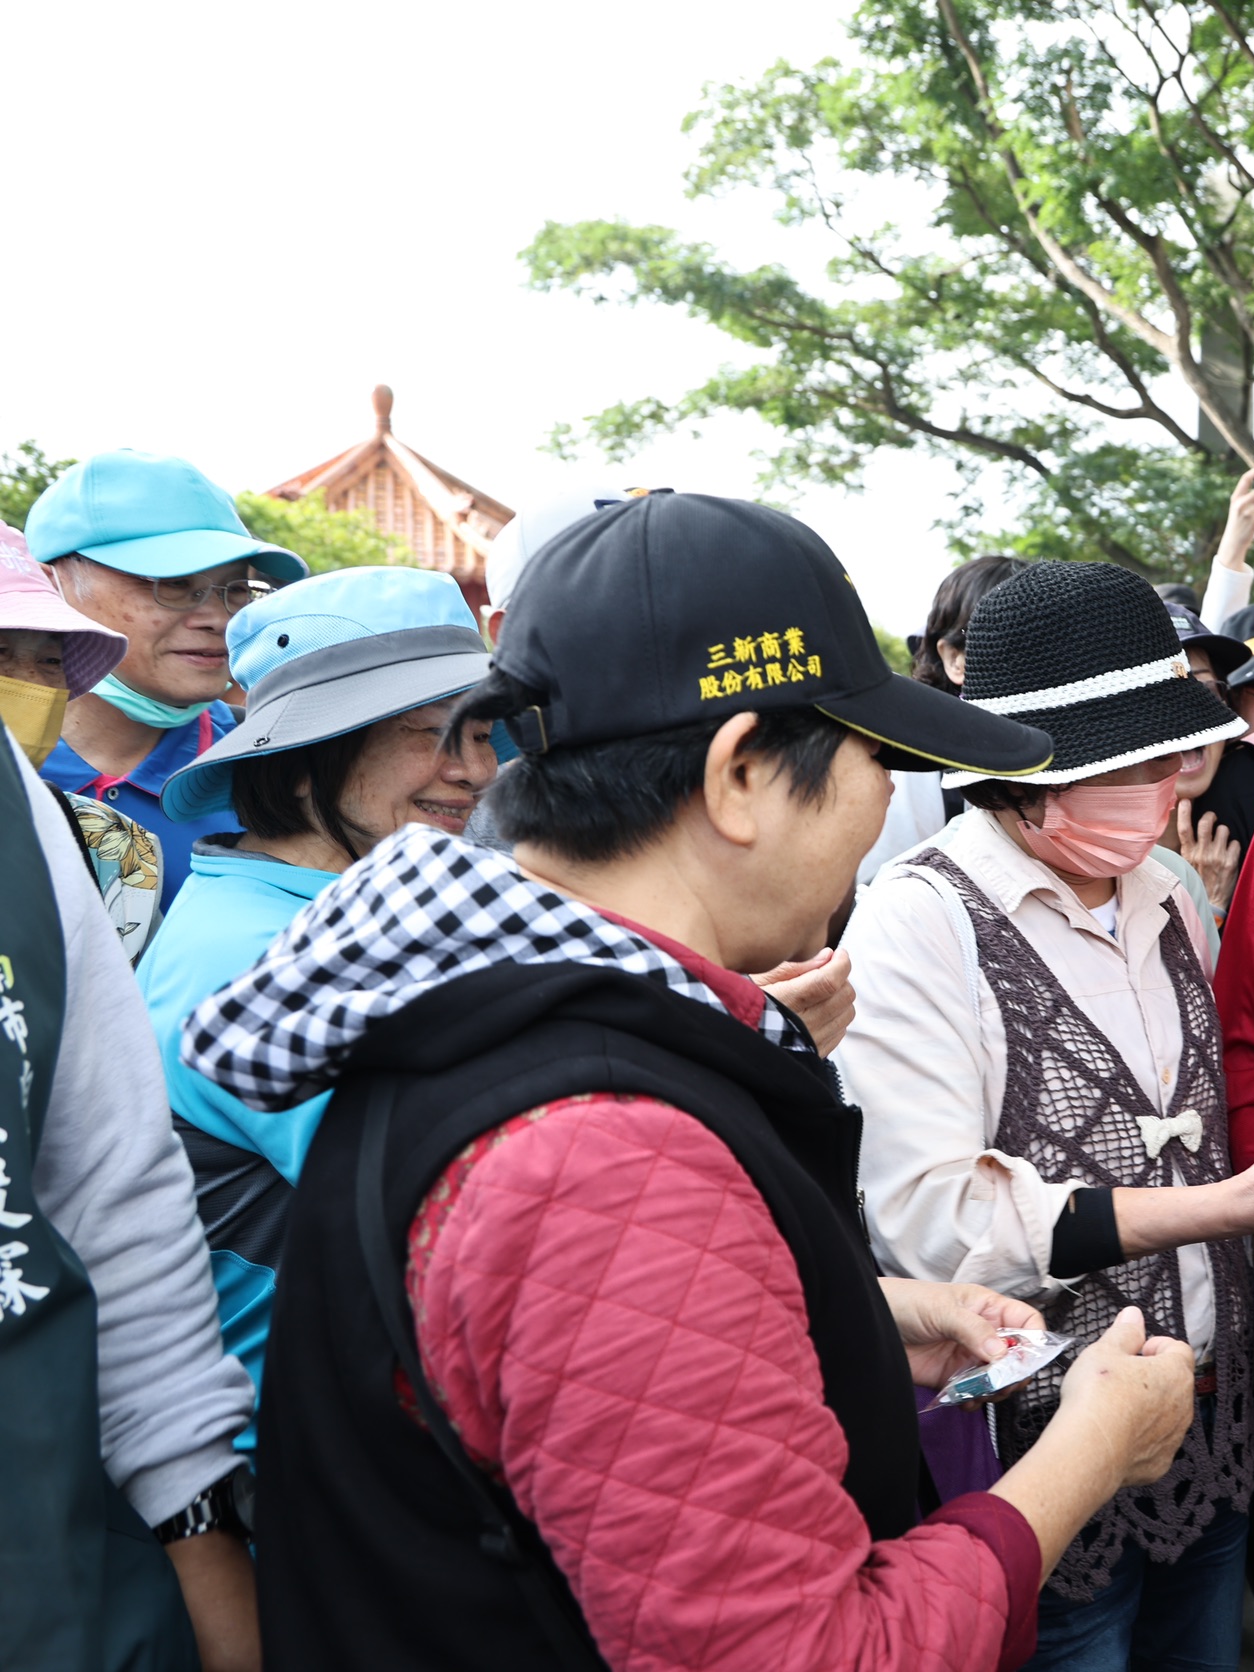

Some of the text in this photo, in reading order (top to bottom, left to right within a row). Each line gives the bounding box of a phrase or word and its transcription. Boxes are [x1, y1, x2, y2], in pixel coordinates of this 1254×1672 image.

[706, 626, 806, 669] 三新商業
[699, 655, 823, 701] 股份有限公司
